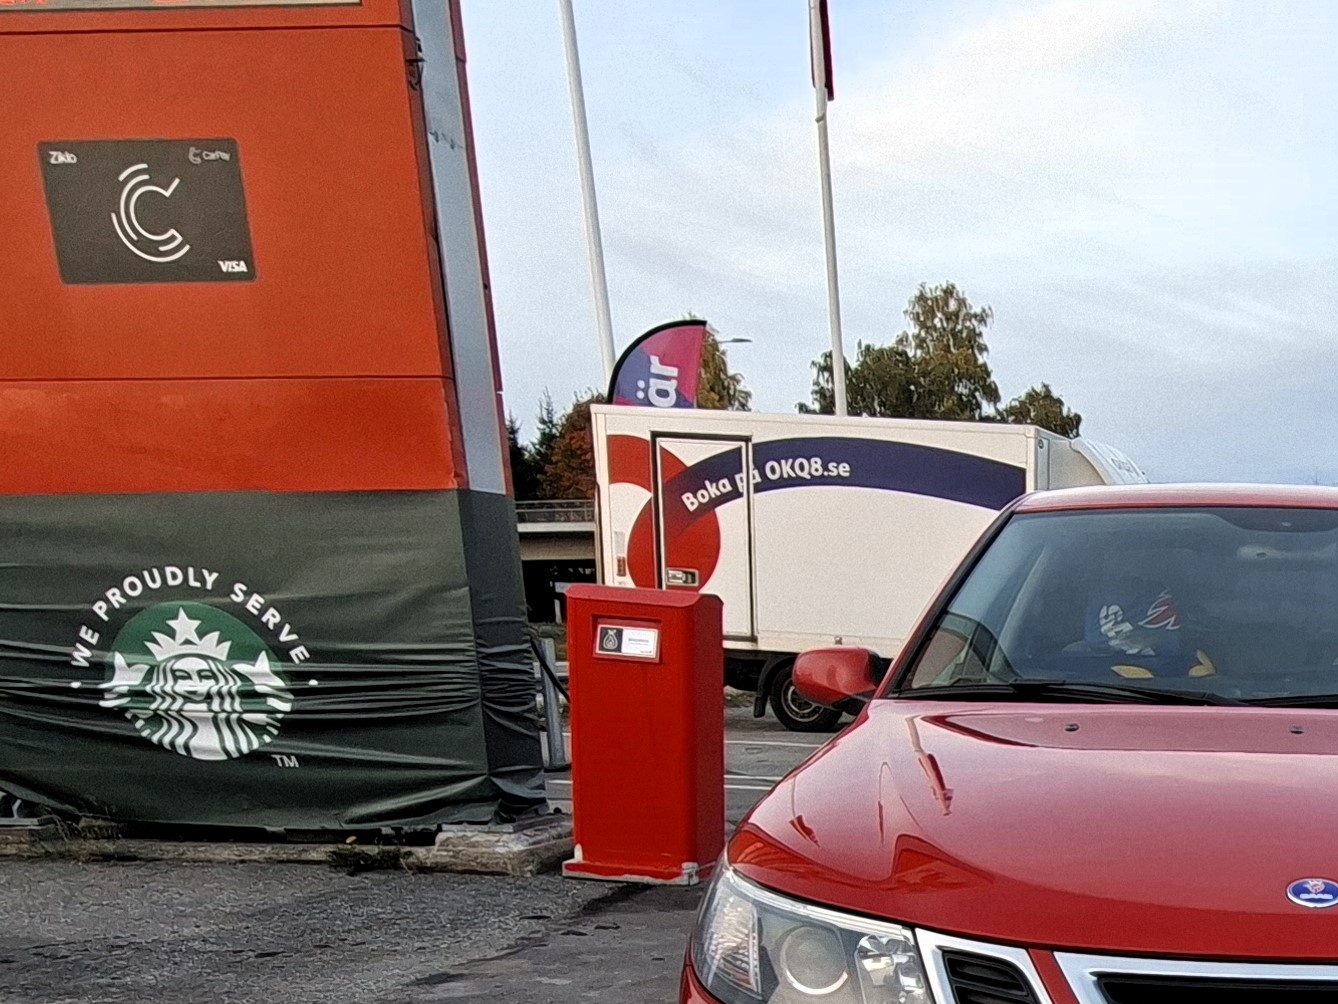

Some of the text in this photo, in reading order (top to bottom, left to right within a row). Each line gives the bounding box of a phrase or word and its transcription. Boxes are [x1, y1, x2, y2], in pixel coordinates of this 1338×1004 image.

[217, 260, 248, 272] VISA
[681, 477, 733, 512] Boka
[765, 457, 851, 480] OKQ8.se
[70, 565, 310, 668] WE PROUDLY SERVE
[270, 754, 299, 768] TM
